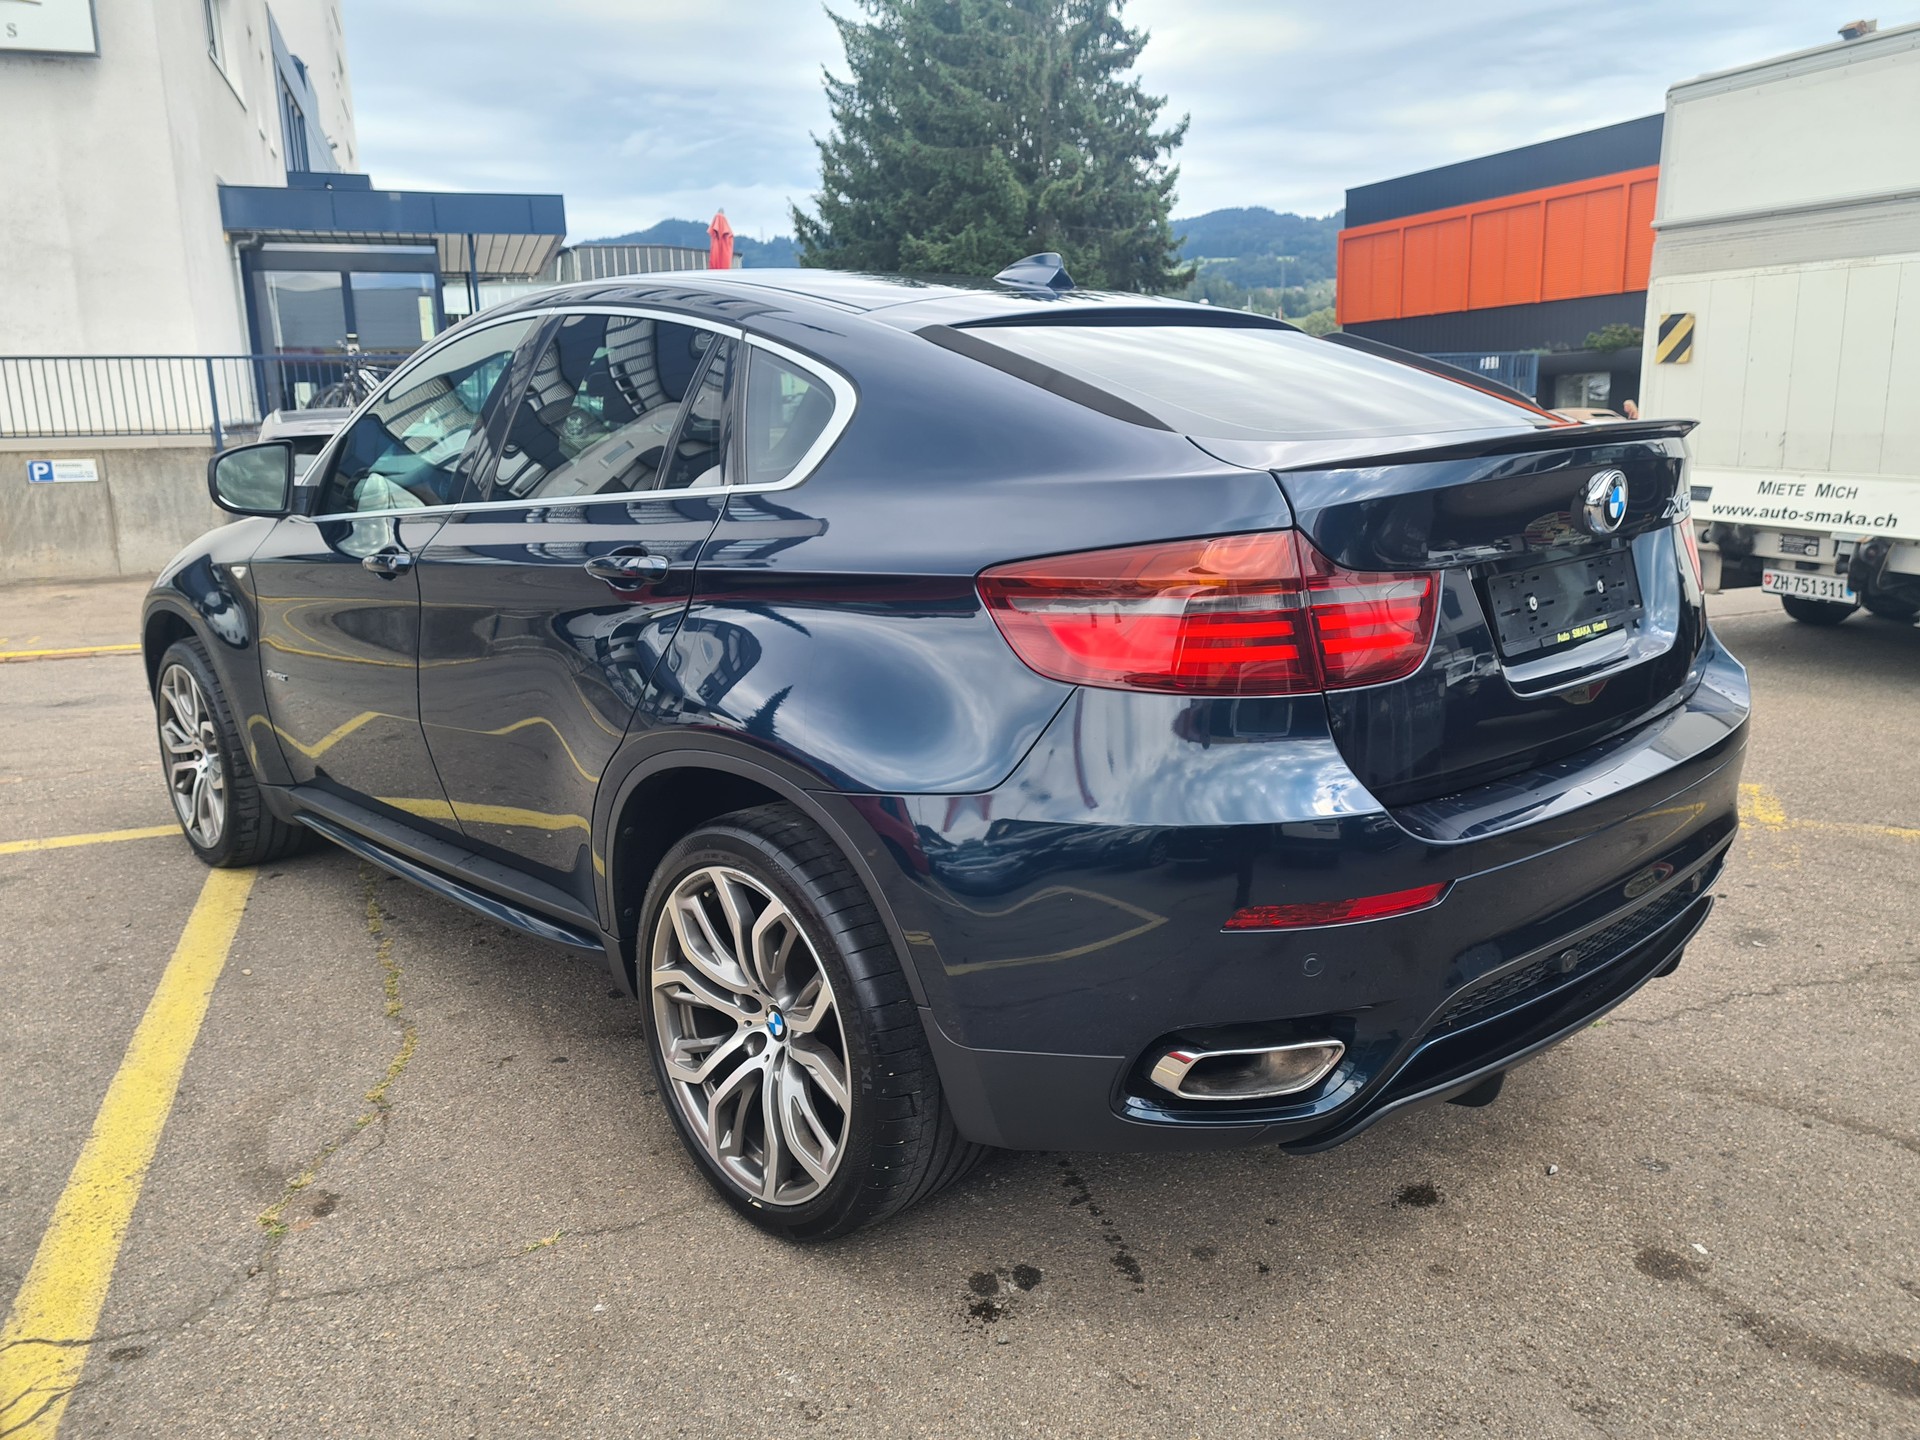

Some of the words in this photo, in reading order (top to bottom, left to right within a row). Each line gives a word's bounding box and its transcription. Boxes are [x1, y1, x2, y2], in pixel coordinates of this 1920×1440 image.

[33, 462, 49, 481] P
[1757, 480, 1806, 497] MIETE
[1815, 482, 1858, 500] MICH
[1712, 503, 1898, 529] www.auto-smaka.ch
